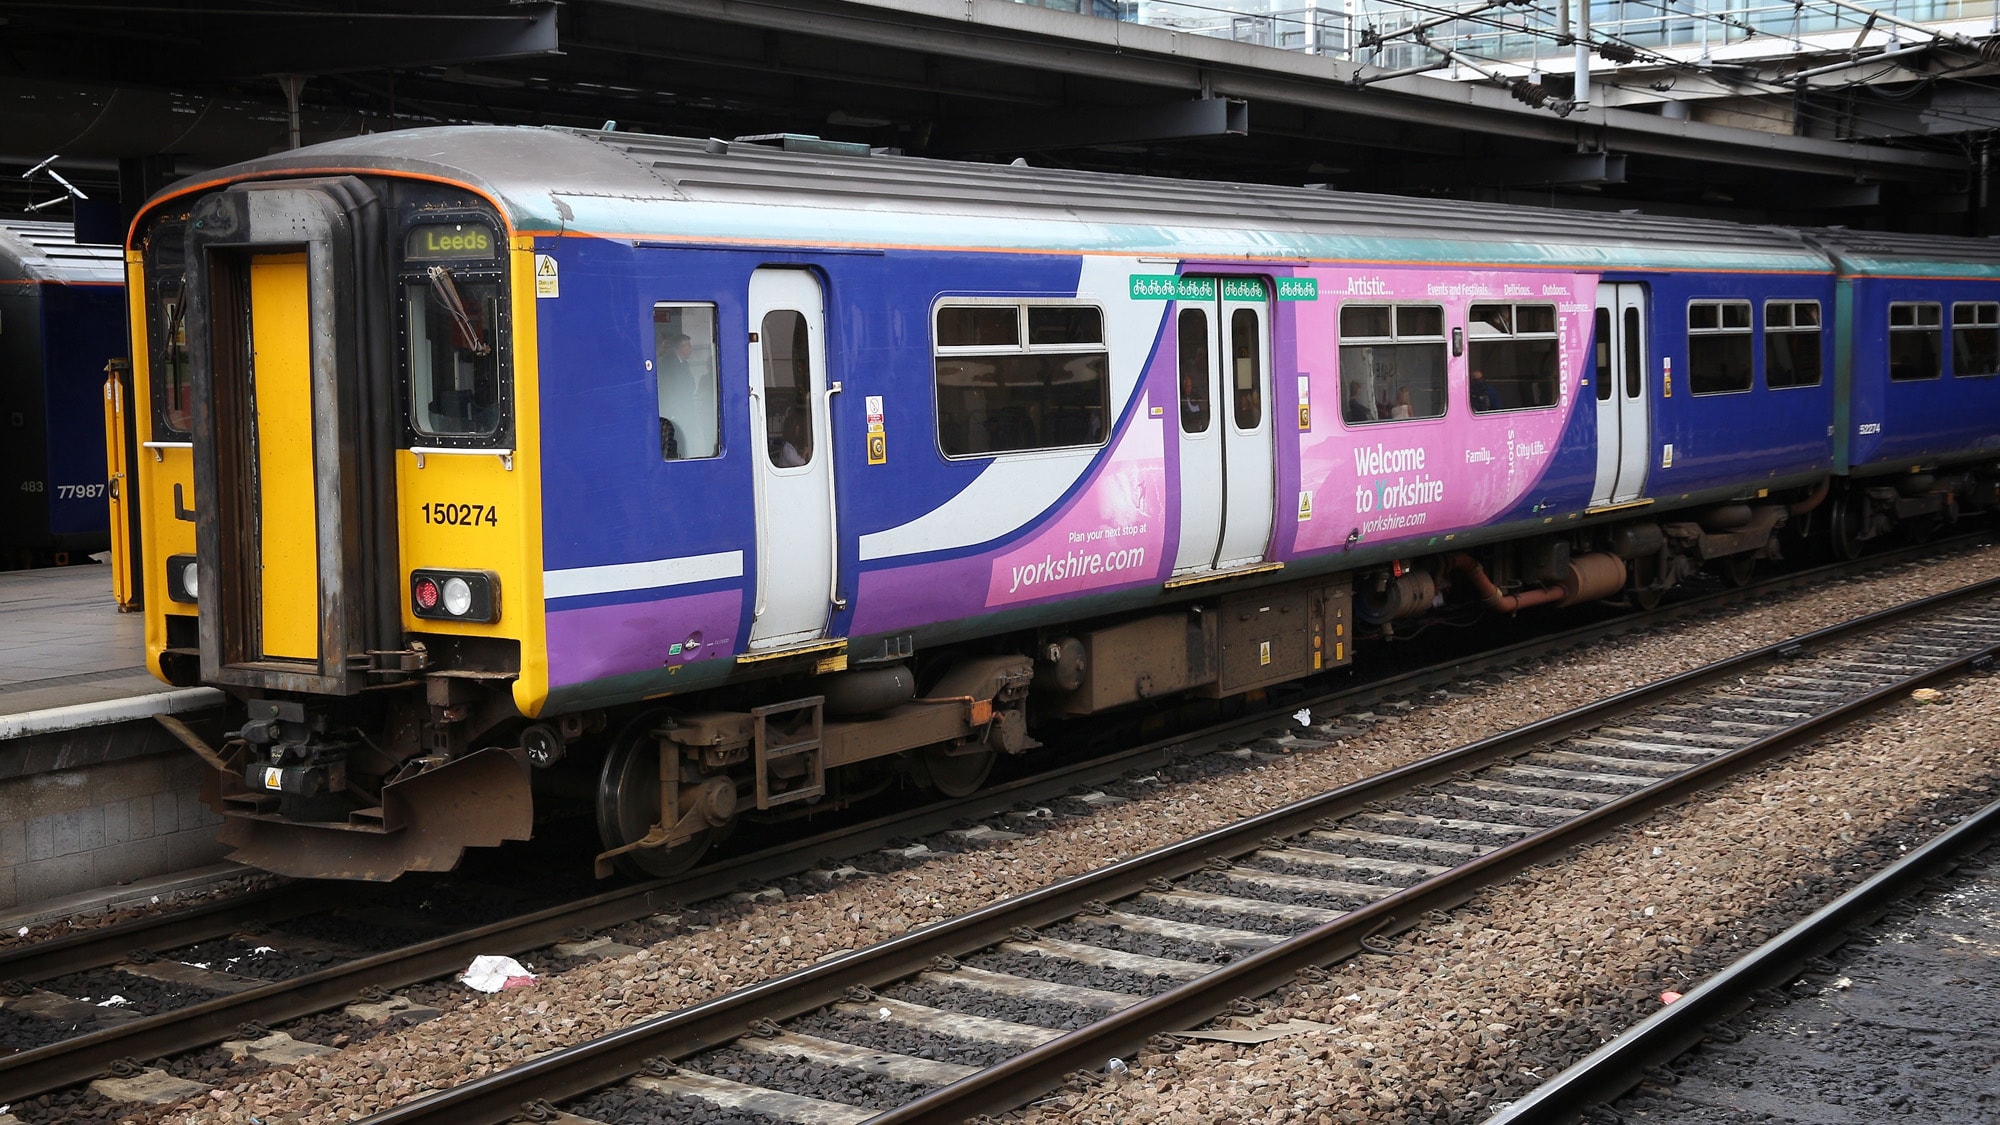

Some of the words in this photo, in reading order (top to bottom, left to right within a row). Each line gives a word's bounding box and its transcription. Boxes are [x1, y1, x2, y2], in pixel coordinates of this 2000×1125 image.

[428, 230, 488, 251] Leeds
[1427, 283, 1448, 296] Events
[1449, 283, 1461, 295] and
[1354, 443, 1425, 477] Welcome
[1516, 444, 1530, 459] City
[21, 481, 44, 493] 483
[57, 484, 105, 499] 77987
[1356, 484, 1373, 513] to
[1375, 473, 1444, 511] Yorkshire
[421, 502, 498, 527] 150274
[1362, 512, 1427, 535] yorkshire.com
[1069, 531, 1085, 543] Plan
[1086, 529, 1104, 543] your
[1104, 526, 1121, 538] next
[1122, 524, 1138, 536] stop
[1139, 522, 1147, 533] at
[1009, 547, 1145, 593] yorkshire.com
